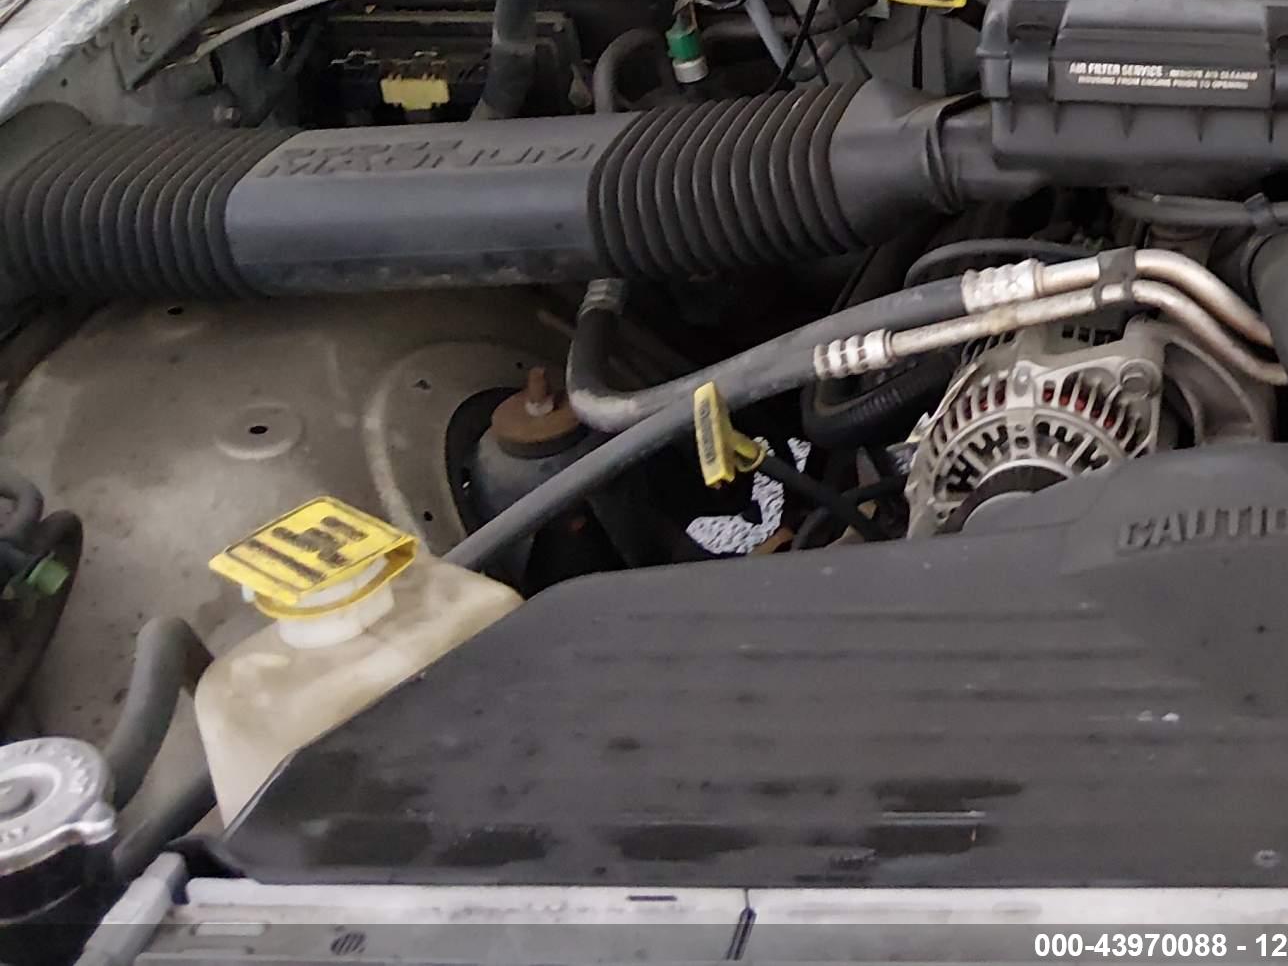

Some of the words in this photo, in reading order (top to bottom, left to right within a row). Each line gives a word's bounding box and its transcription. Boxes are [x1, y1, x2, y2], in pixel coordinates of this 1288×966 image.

[1087, 63, 1121, 75] FILTER
[1121, 64, 1163, 77] SERVICE
[256, 139, 597, 178] MAGNUM
